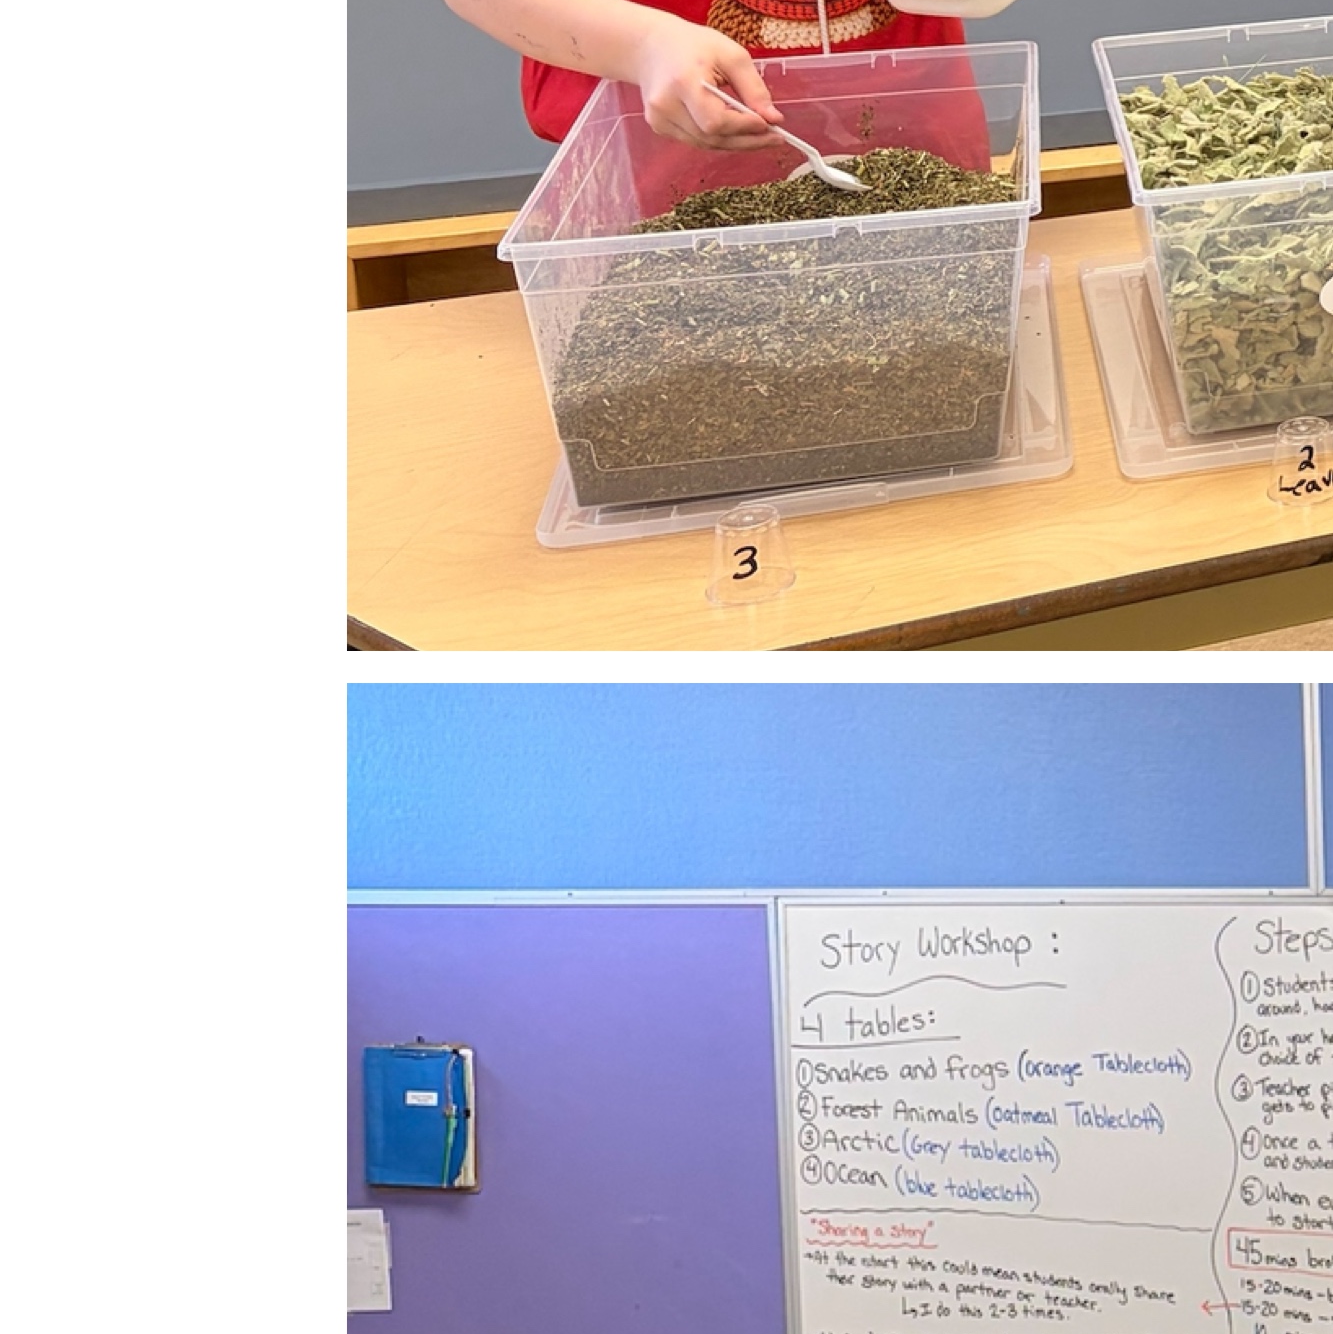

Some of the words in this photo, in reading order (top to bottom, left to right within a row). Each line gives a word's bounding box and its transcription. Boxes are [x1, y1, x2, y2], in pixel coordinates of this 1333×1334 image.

[1298, 445, 1315, 471] 2
[733, 546, 758, 580] 3
[820, 929, 901, 975] Story
[800, 1013, 823, 1042] 4
[845, 1005, 935, 1041] tables:
[1259, 1028, 1279, 1046] In
[900, 1057, 935, 1080] and
[945, 1055, 1010, 1091] frogs
[1254, 1077, 1311, 1097] Teacher
[821, 1096, 883, 1120] Forest
[893, 1100, 979, 1124] Animals
[821, 1131, 901, 1153] Arctic
[1307, 1139, 1321, 1150] a
[1265, 1182, 1310, 1206] When
